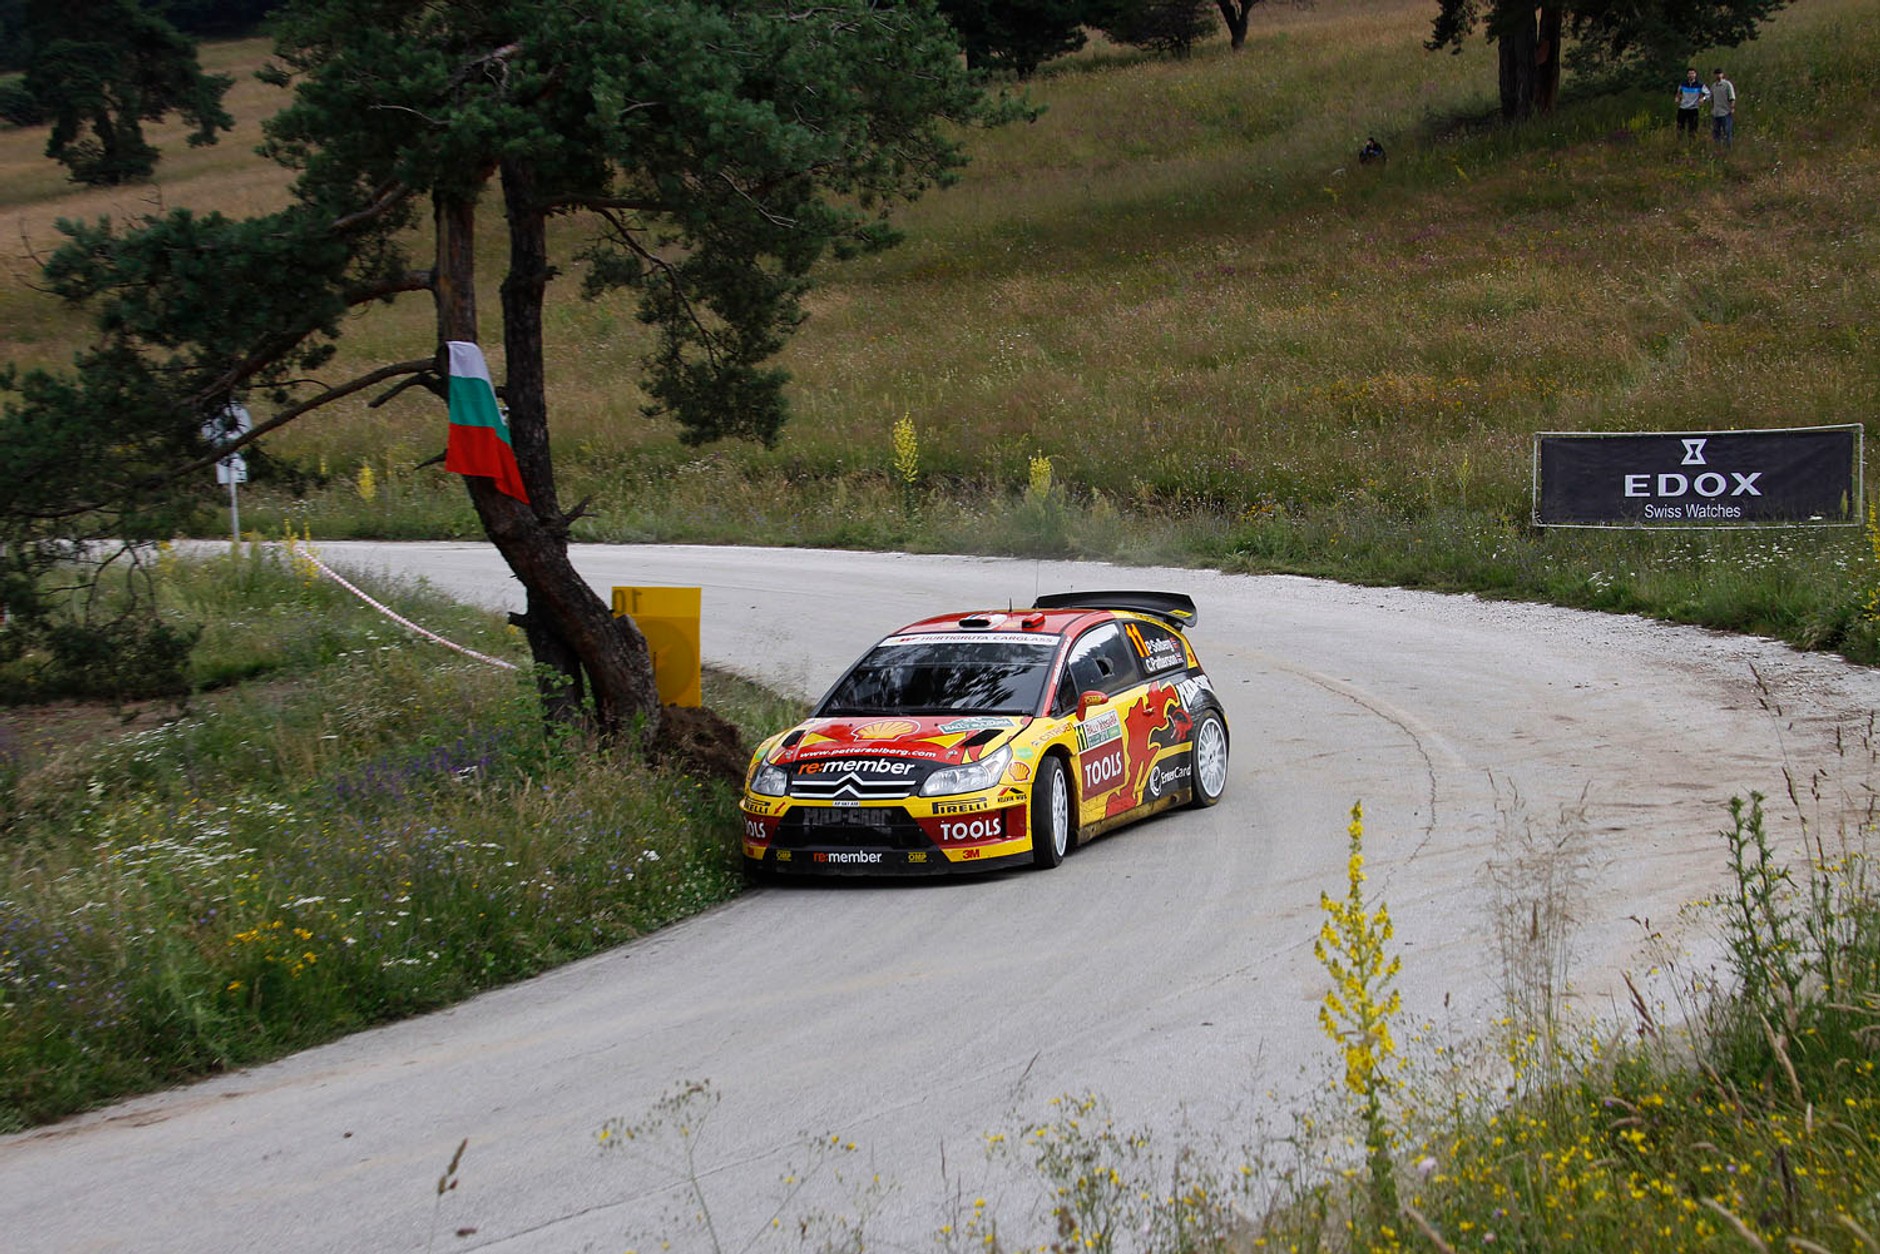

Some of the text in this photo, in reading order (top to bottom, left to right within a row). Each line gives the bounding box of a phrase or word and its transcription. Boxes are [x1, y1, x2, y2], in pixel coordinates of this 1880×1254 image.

[1624, 472, 1762, 498] EDOX
[1644, 503, 1741, 519] Swiss Watches
[1124, 623, 1151, 658] 11
[1076, 724, 1088, 751] 11
[799, 746, 937, 758] www.pettersolberg.com
[798, 758, 916, 775] re:member
[1085, 751, 1122, 788] TOOLS
[1160, 763, 1191, 784] EnterCard
[932, 797, 987, 815] PIRELLI
[940, 816, 1001, 841] TOOLS
[813, 850, 882, 863] re:member
[908, 853, 927, 862] OMP
[963, 849, 980, 859] 3M
